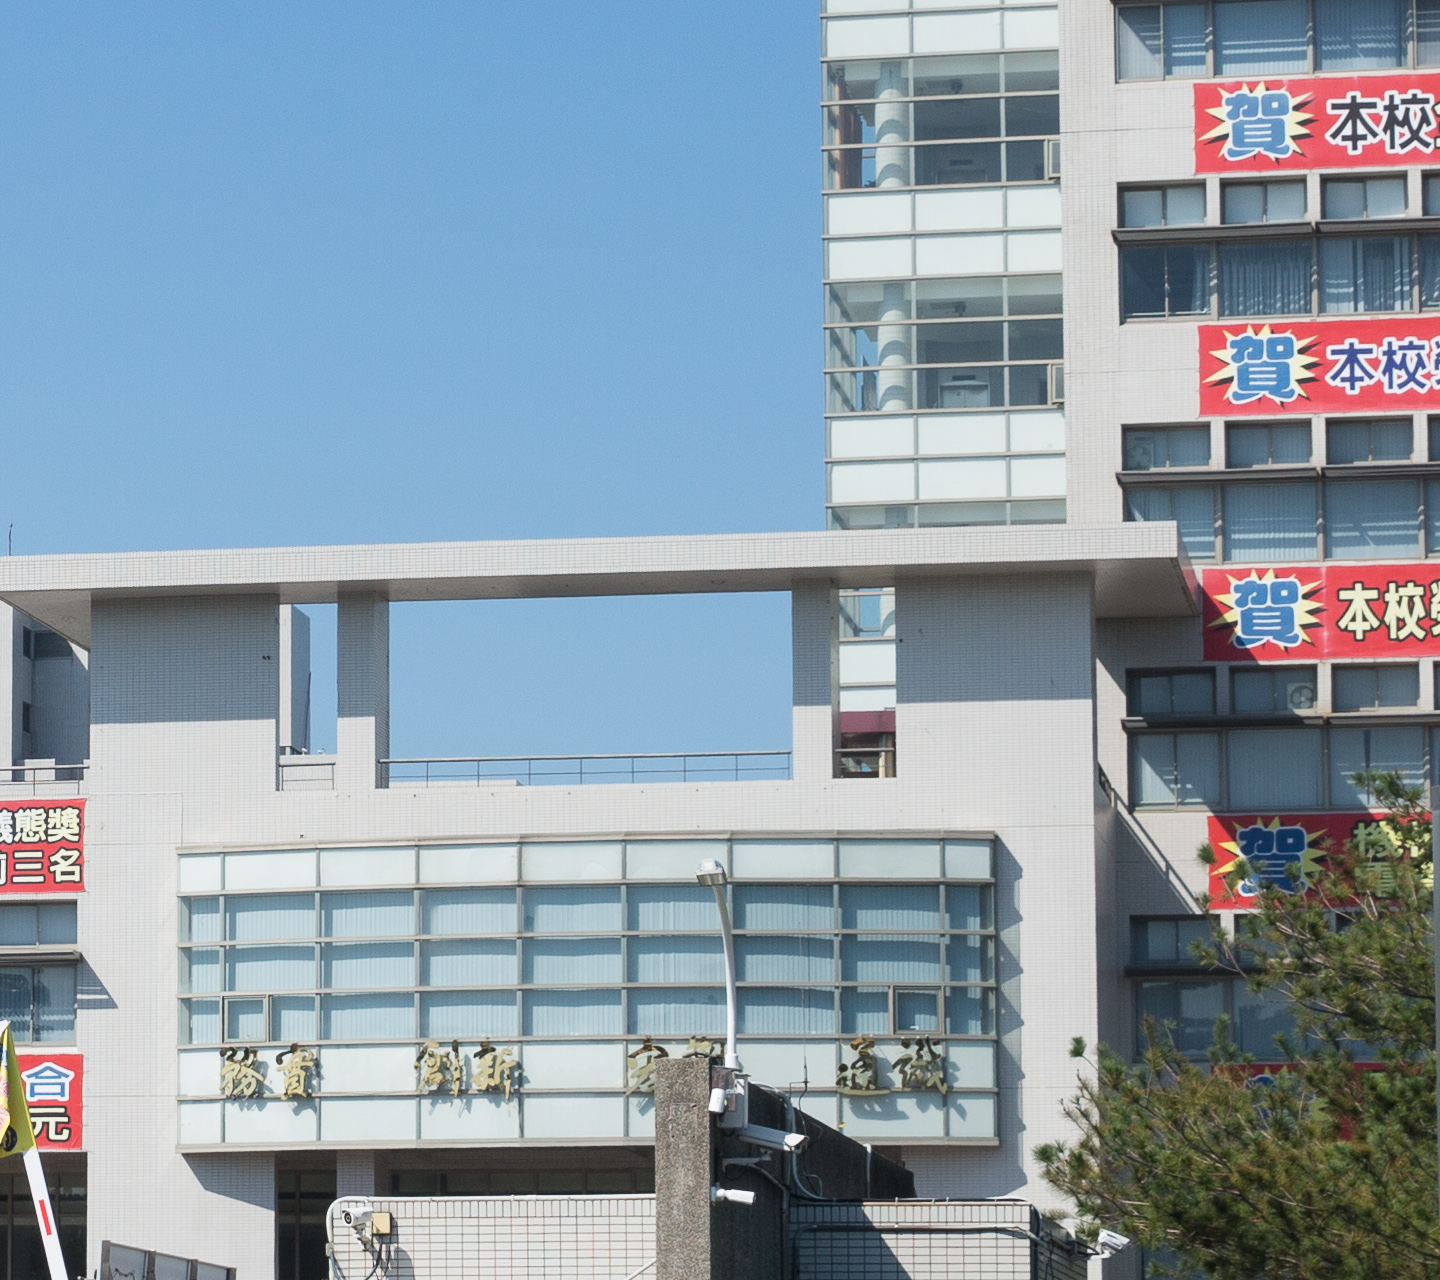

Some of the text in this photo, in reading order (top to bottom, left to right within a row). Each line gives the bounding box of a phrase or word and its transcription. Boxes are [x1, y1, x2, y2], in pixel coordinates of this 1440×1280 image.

[1225, 91, 1291, 161] 賀
[1229, 335, 1297, 405] 賀
[1234, 577, 1301, 648] 賀
[1236, 826, 1309, 896] 賀
